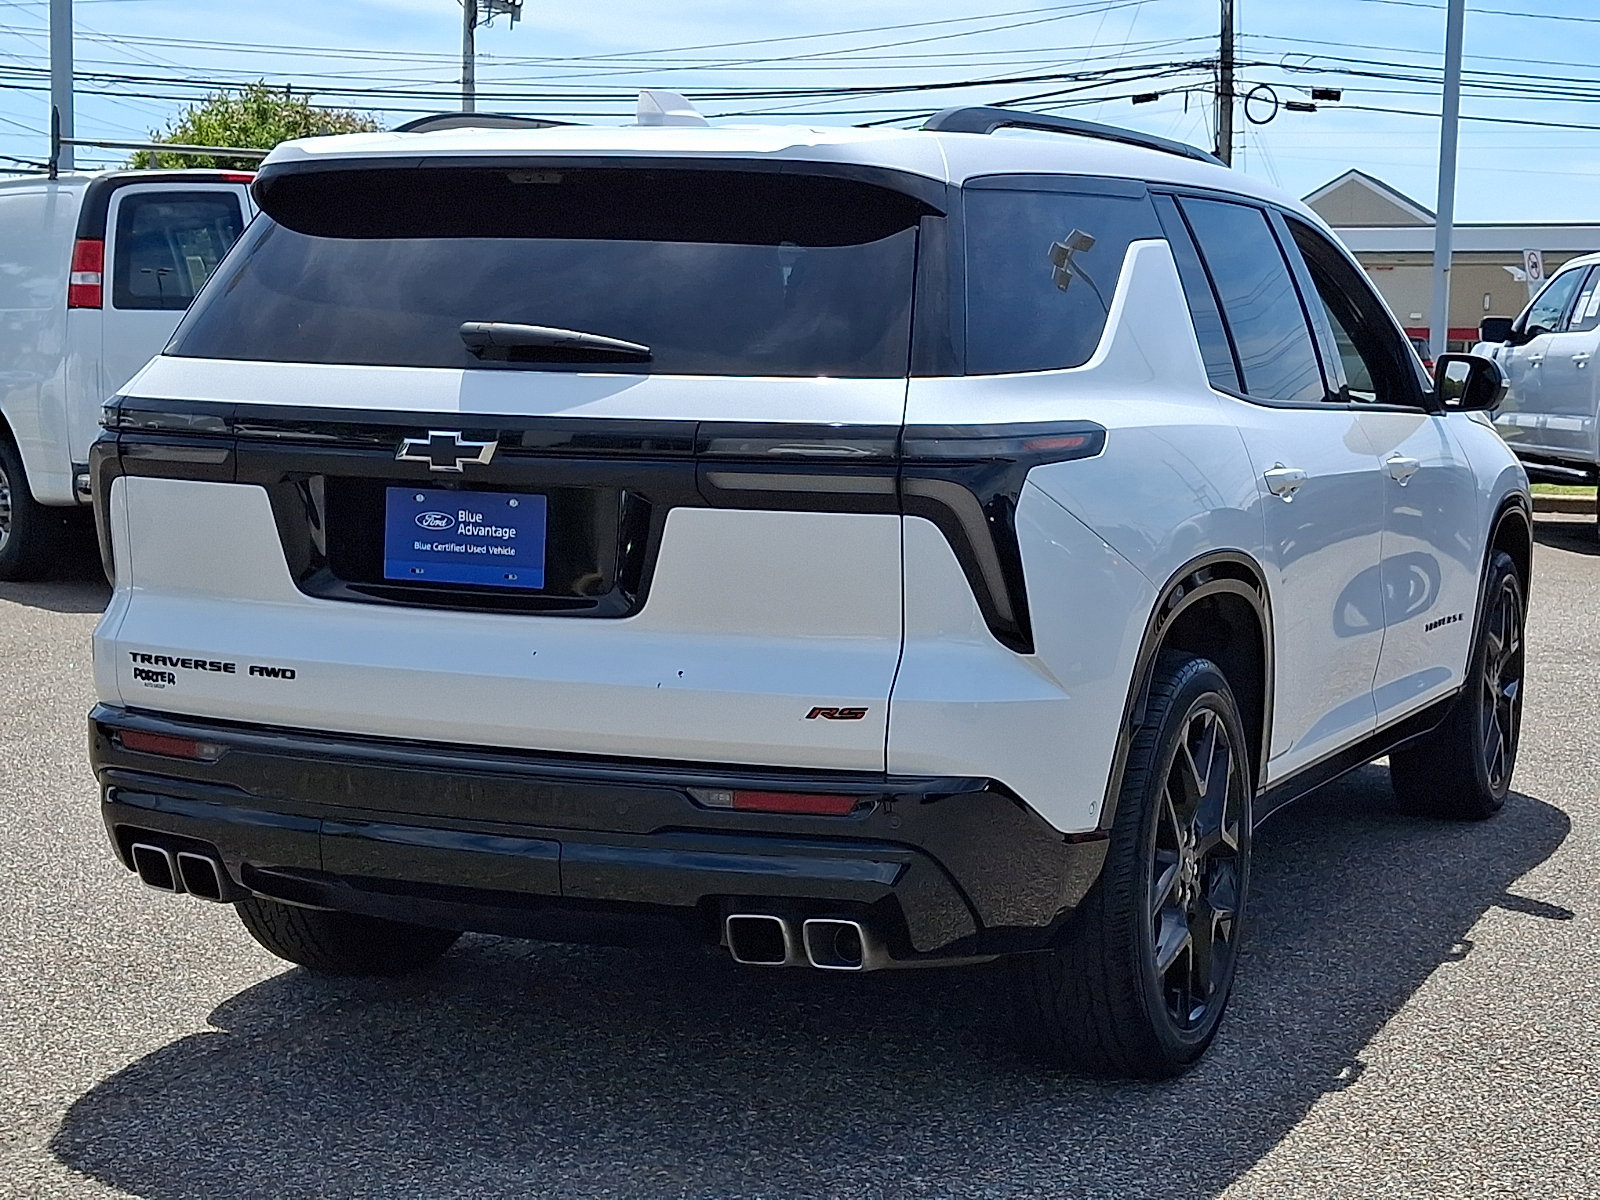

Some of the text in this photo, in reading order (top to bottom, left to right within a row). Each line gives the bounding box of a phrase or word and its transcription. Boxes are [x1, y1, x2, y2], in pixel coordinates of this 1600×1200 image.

[422, 514, 448, 527] Ford
[458, 510, 483, 523] Blue
[457, 523, 517, 540] Advantage
[414, 541, 516, 556] Blue Certified Used Vehicle
[129, 652, 296, 680] TRAVERSE AWD
[133, 667, 176, 686] PORTER
[805, 706, 869, 720] RS
